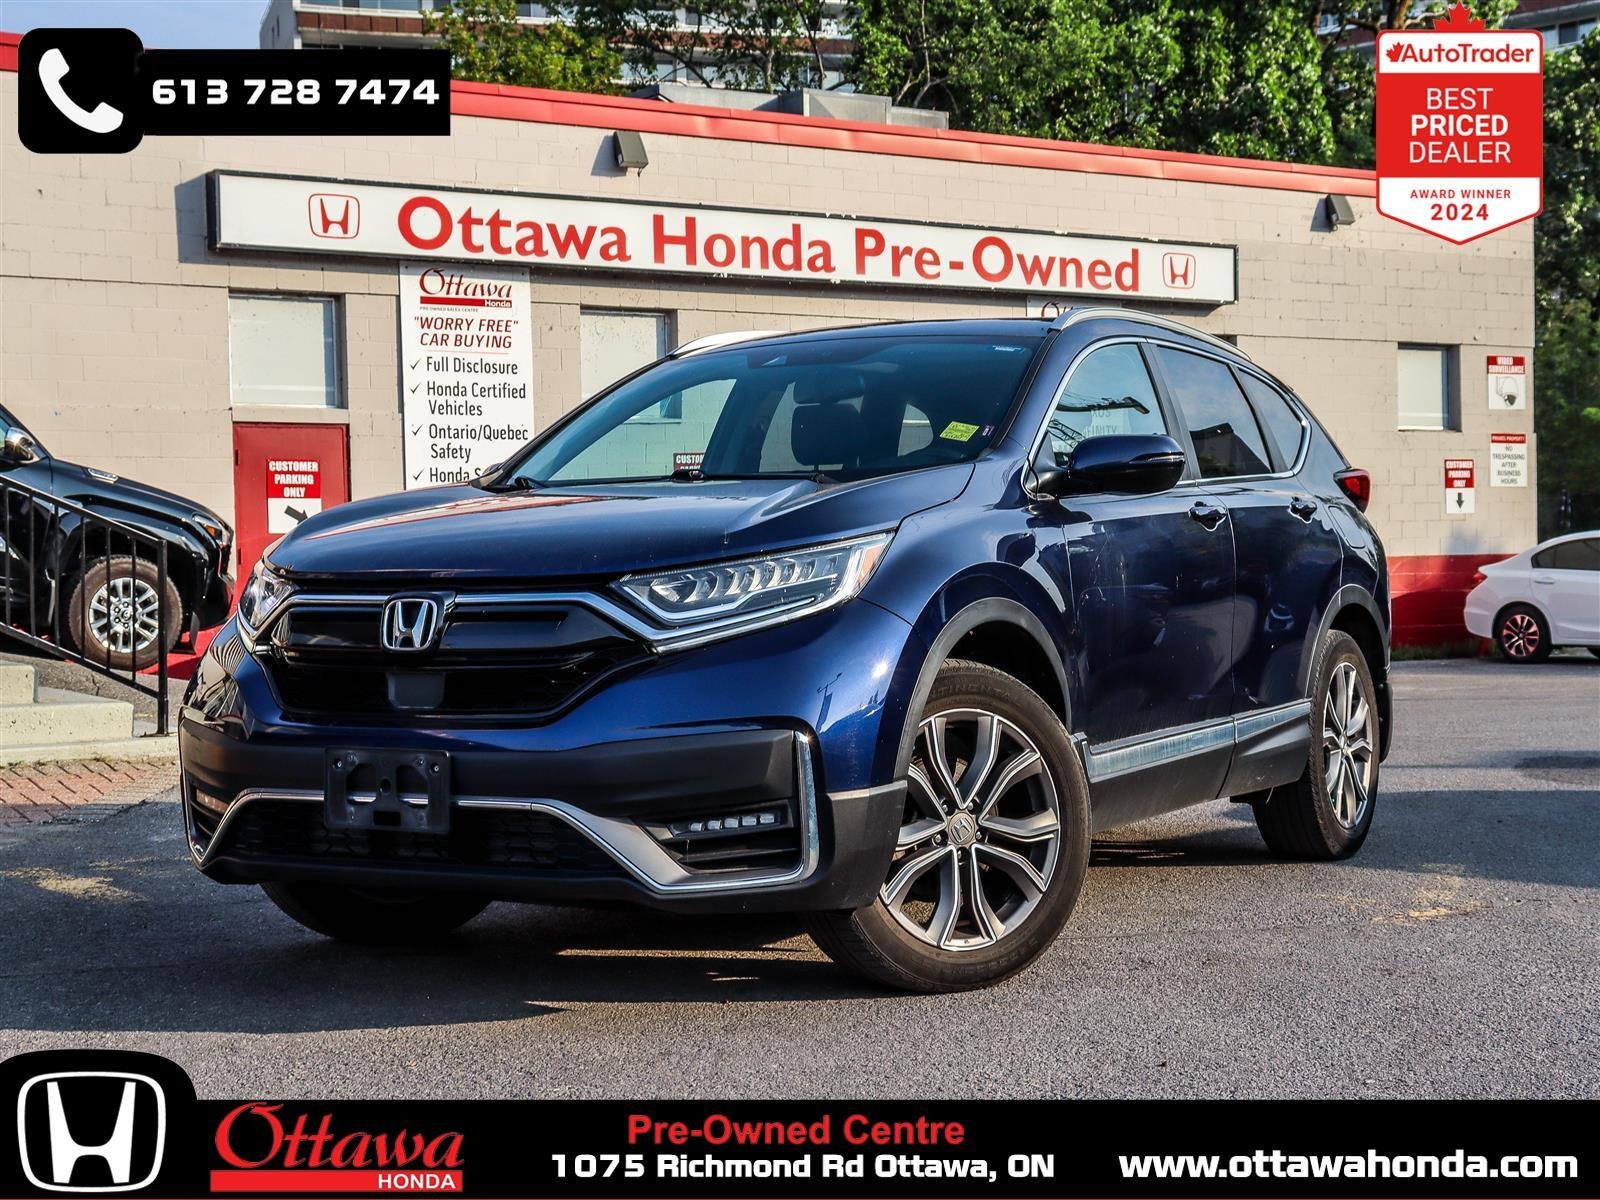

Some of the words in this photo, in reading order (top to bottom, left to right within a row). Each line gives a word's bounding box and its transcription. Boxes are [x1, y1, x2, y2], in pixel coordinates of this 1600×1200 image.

[397, 196, 632, 262] Ottawa
[652, 213, 836, 274] Honda
[854, 227, 1140, 292] Pre-Owned
[418, 268, 513, 298] Ottawa
[484, 299, 512, 309] Honda
[414, 316, 474, 332] "WORRY
[478, 318, 519, 333] FREE"
[420, 332, 450, 347] CAR
[454, 334, 512, 349] BUYING
[426, 356, 449, 373] Full
[453, 357, 518, 375] Disclosure
[427, 380, 467, 397] Honda
[471, 382, 527, 399] Certified
[428, 399, 483, 417] Vehicles
[429, 423, 529, 441] Ontario/Quebec
[431, 442, 471, 464] Safety
[268, 460, 319, 472] CUSTOMER
[429, 467, 470, 482] Honda
[274, 473, 315, 485] PARKING
[283, 486, 306, 498] ONLY
